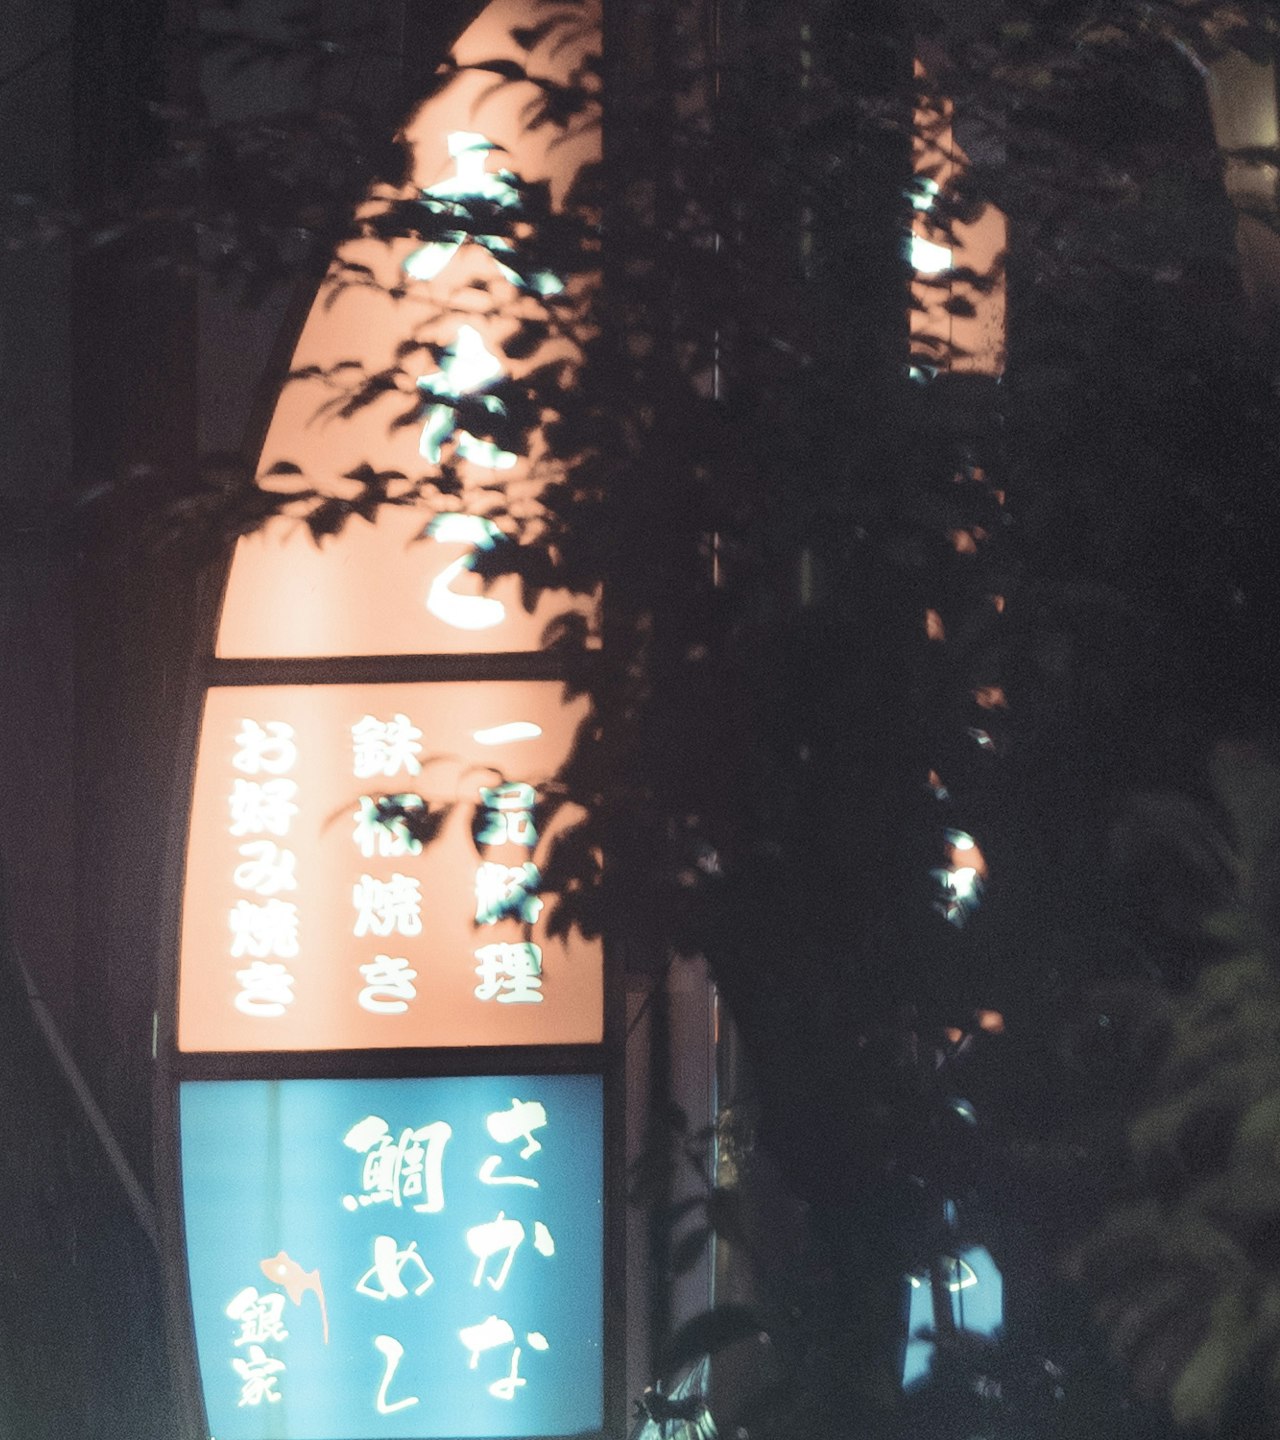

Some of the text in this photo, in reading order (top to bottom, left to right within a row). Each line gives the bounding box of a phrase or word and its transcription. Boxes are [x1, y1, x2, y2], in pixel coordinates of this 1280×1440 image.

[226, 718, 301, 1018] お好み焼き
[472, 720, 545, 1006] 一品料理
[343, 1115, 452, 1414] 鯛めし
[459, 1098, 556, 1401] さかな
